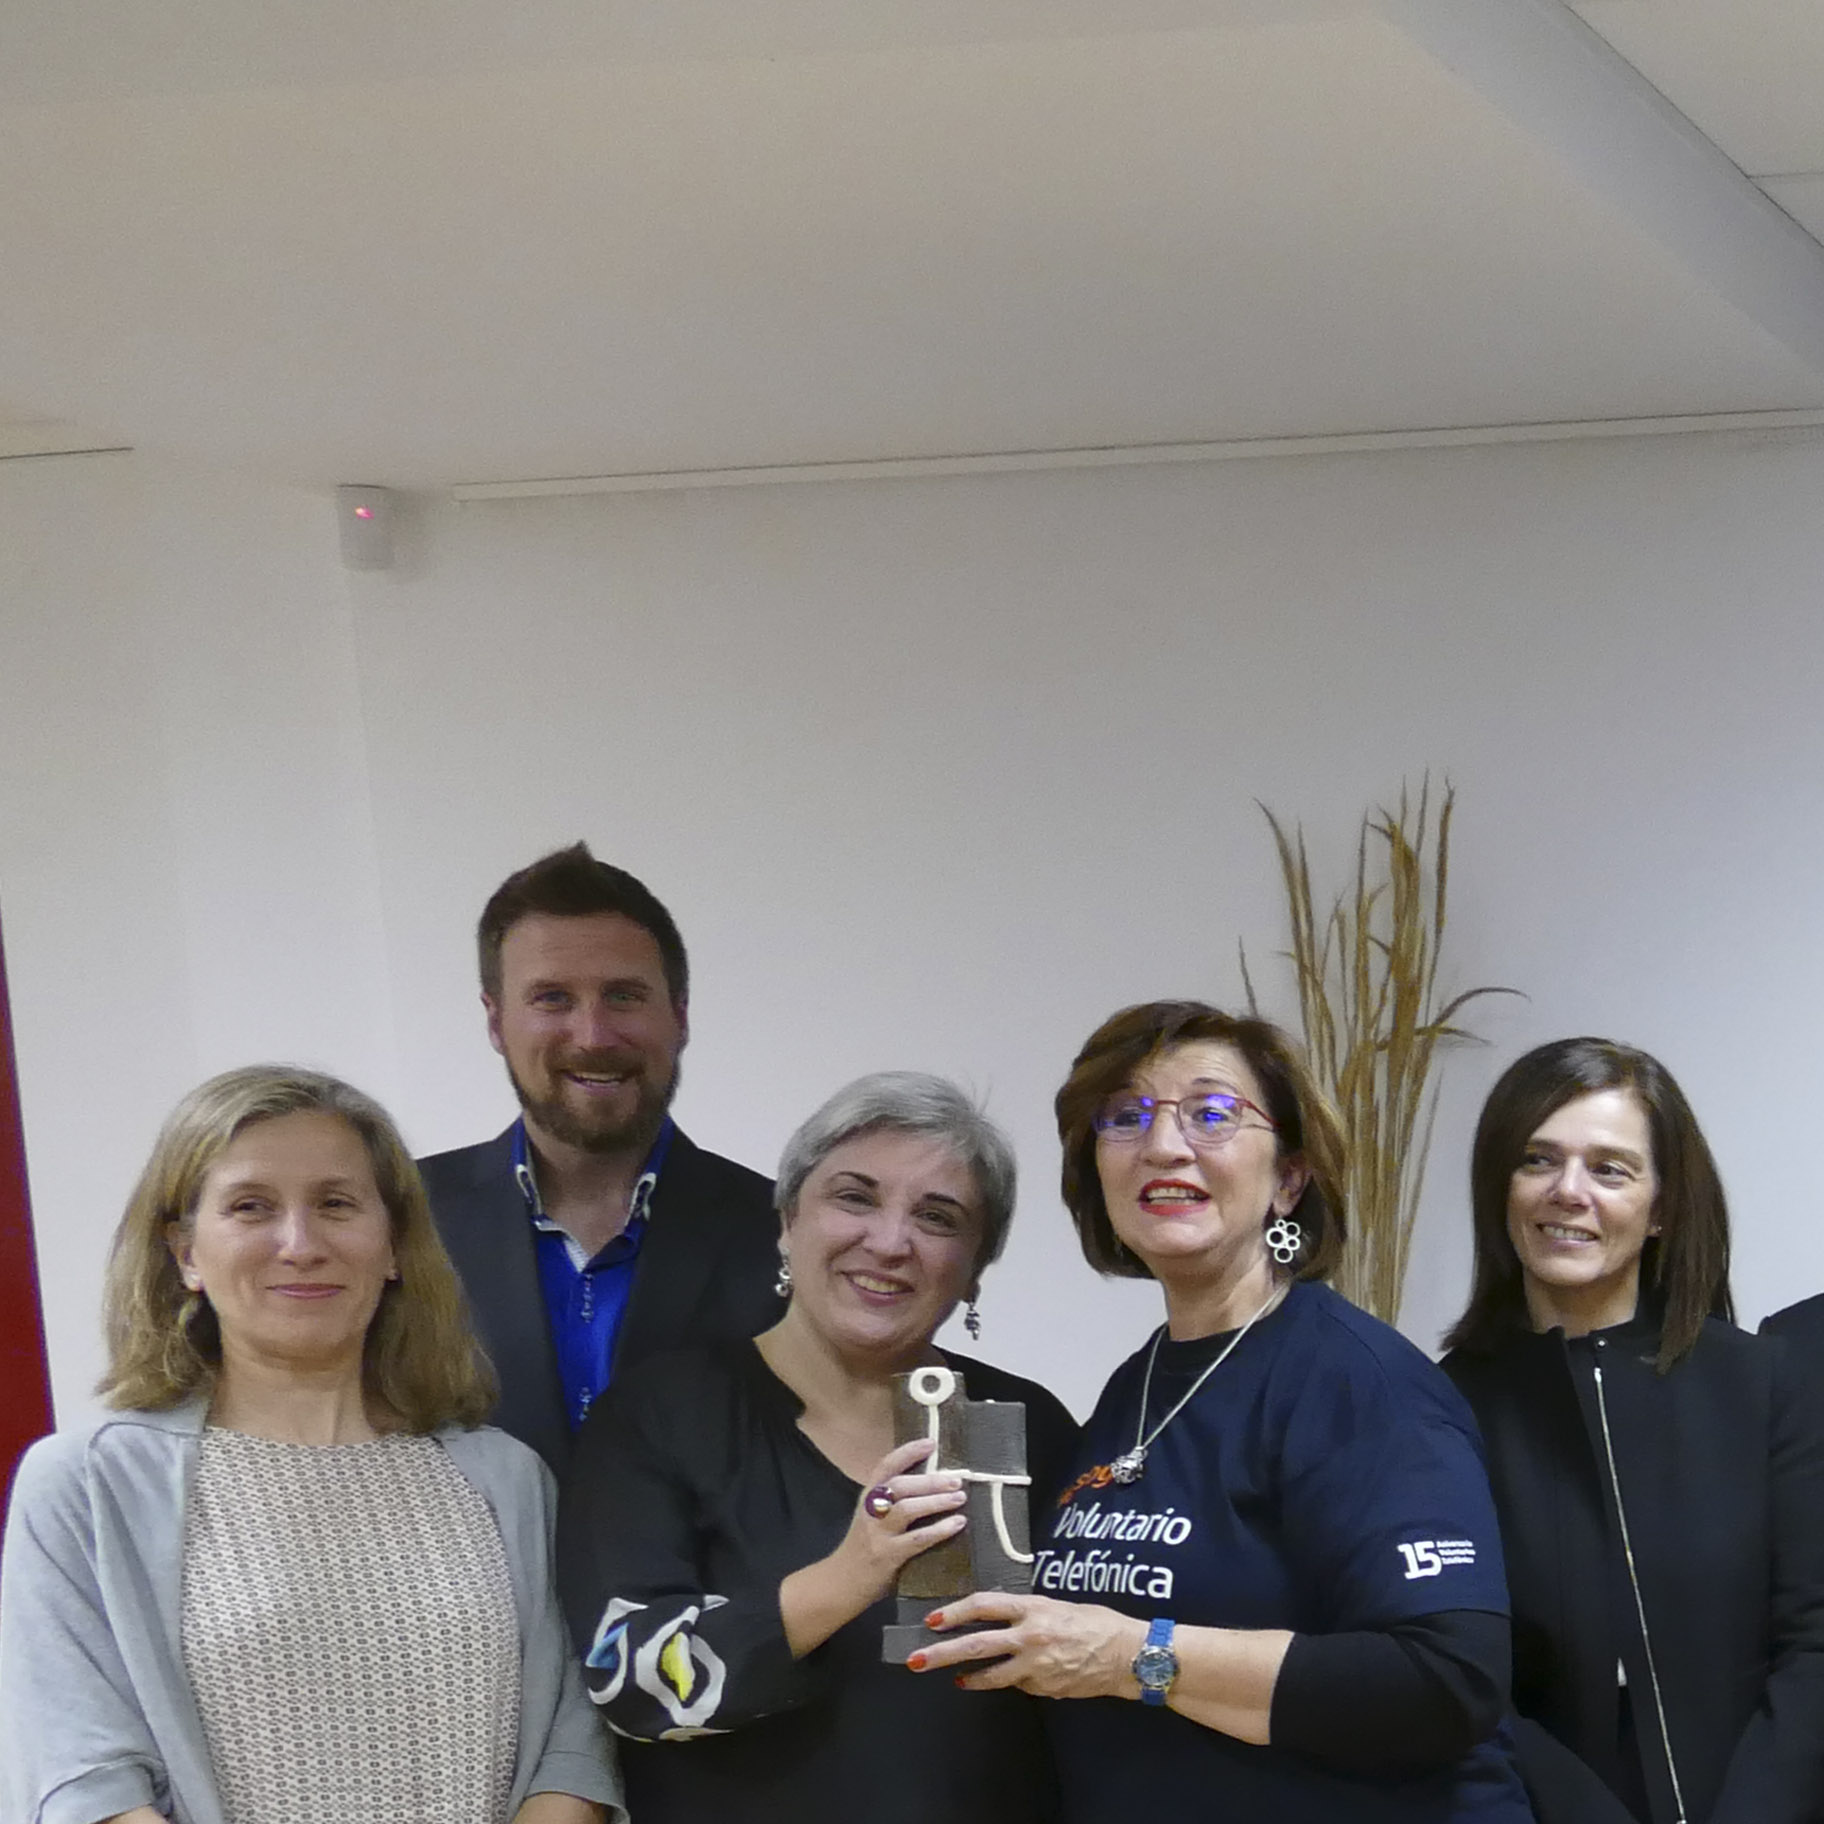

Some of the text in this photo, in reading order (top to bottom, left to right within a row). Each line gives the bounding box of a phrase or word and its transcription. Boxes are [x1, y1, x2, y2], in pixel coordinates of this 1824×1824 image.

[1053, 1502, 1192, 1545] Voluntario
[1031, 1550, 1174, 1599] Telefónica
[1397, 1541, 1442, 1580] 15
